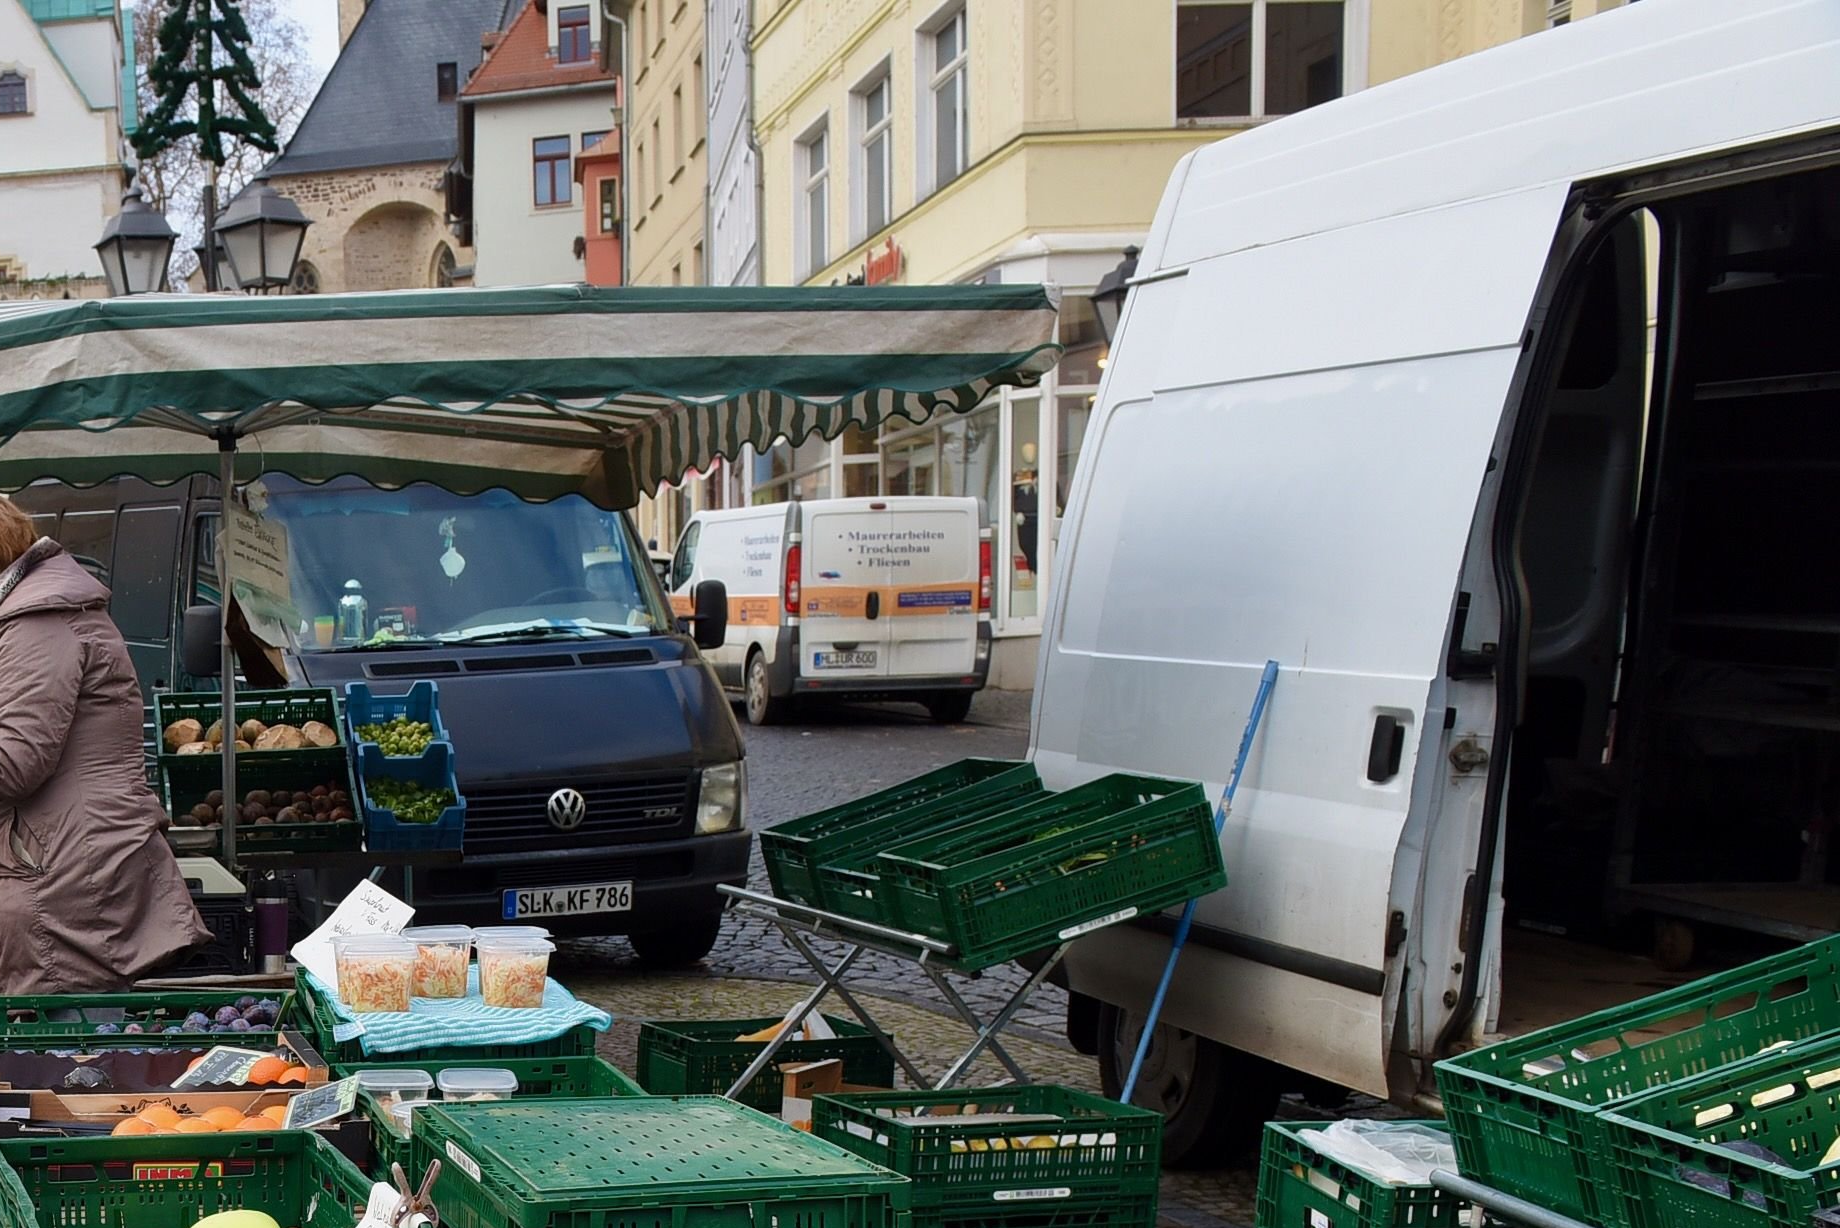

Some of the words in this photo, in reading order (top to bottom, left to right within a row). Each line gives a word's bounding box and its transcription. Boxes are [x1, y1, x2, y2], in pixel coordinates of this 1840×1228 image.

[848, 529, 945, 541] Maurerarbeiten
[858, 543, 931, 555] Trockenbau
[868, 556, 911, 568] Fliesen
[518, 891, 554, 914] SLK
[567, 889, 591, 911] KF
[595, 886, 629, 909] 786
